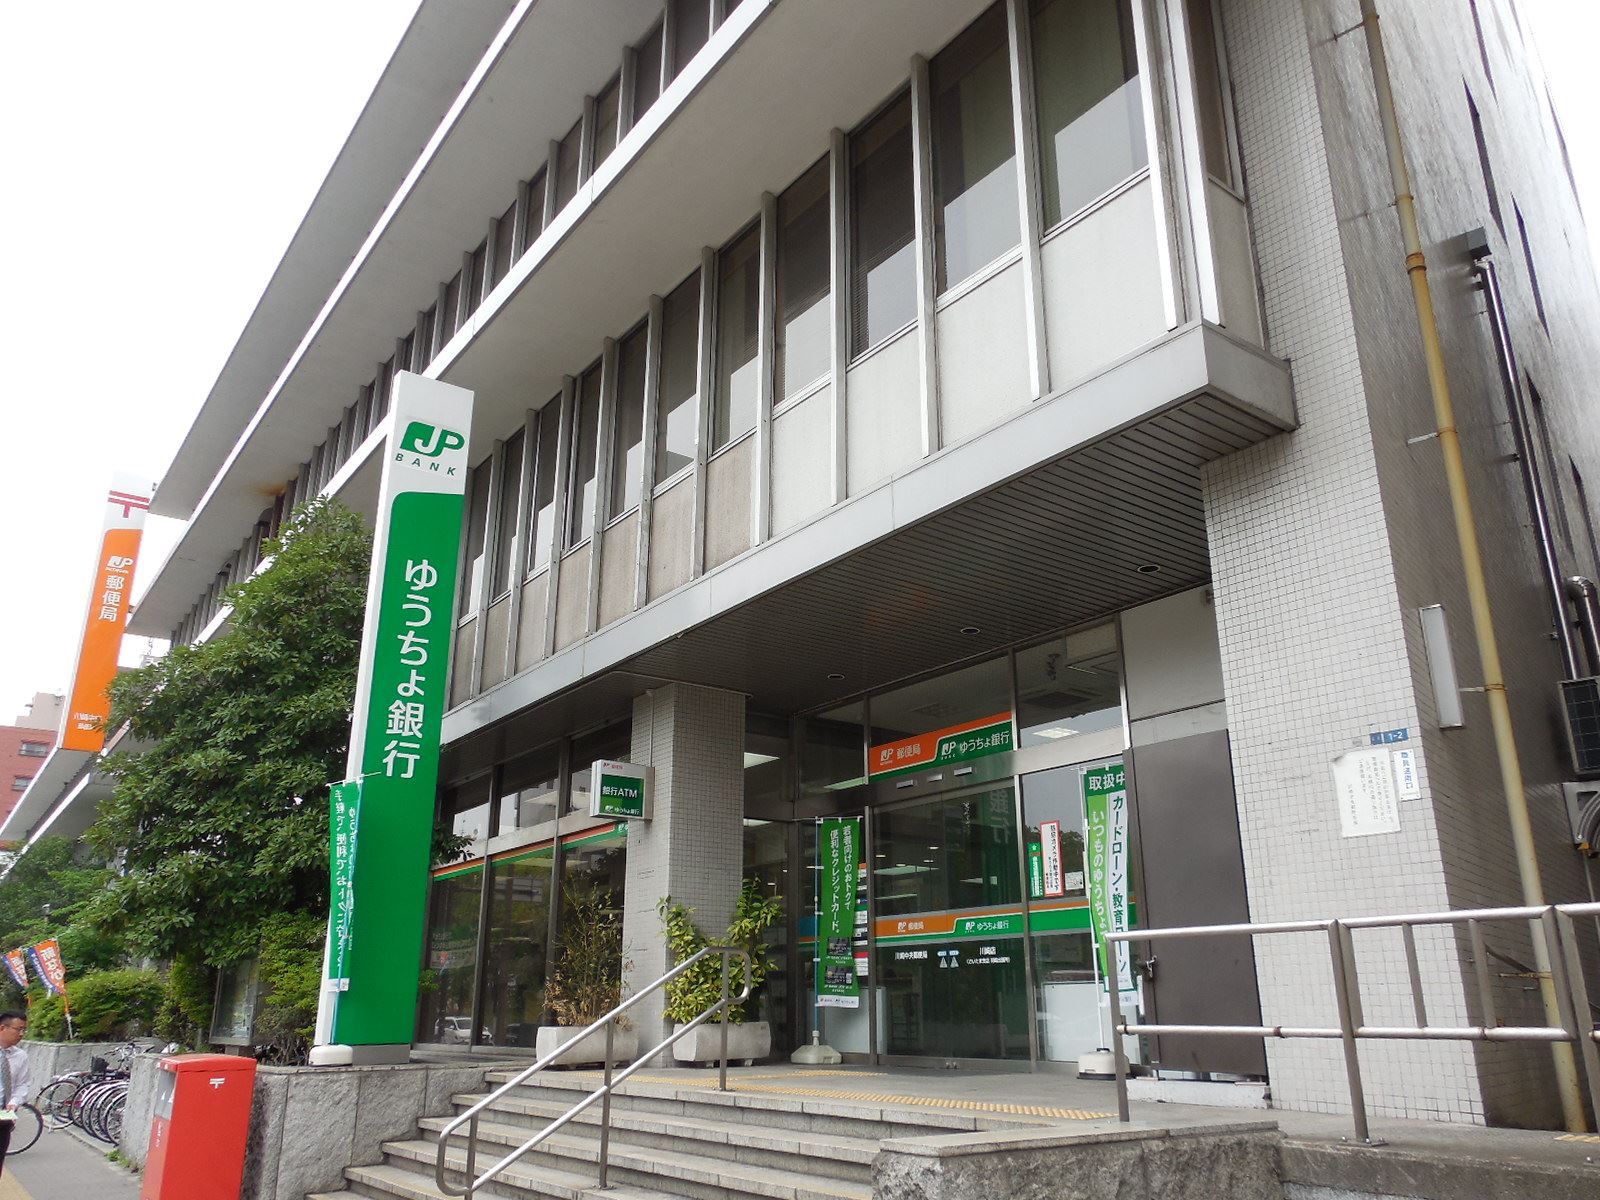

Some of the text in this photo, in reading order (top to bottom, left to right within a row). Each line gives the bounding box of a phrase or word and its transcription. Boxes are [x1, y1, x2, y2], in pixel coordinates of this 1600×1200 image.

[395, 453, 456, 476] BANK
[98, 575, 125, 622] 郵便局
[382, 558, 438, 779] ゆうちょ銀行
[896, 743, 921, 759] 郵便局
[960, 731, 1010, 754] ゆうちょ銀行
[602, 785, 638, 799] 銀行ATM
[1088, 772, 1125, 792] 取扱中
[977, 920, 1009, 931] ゆうちょ銀行
